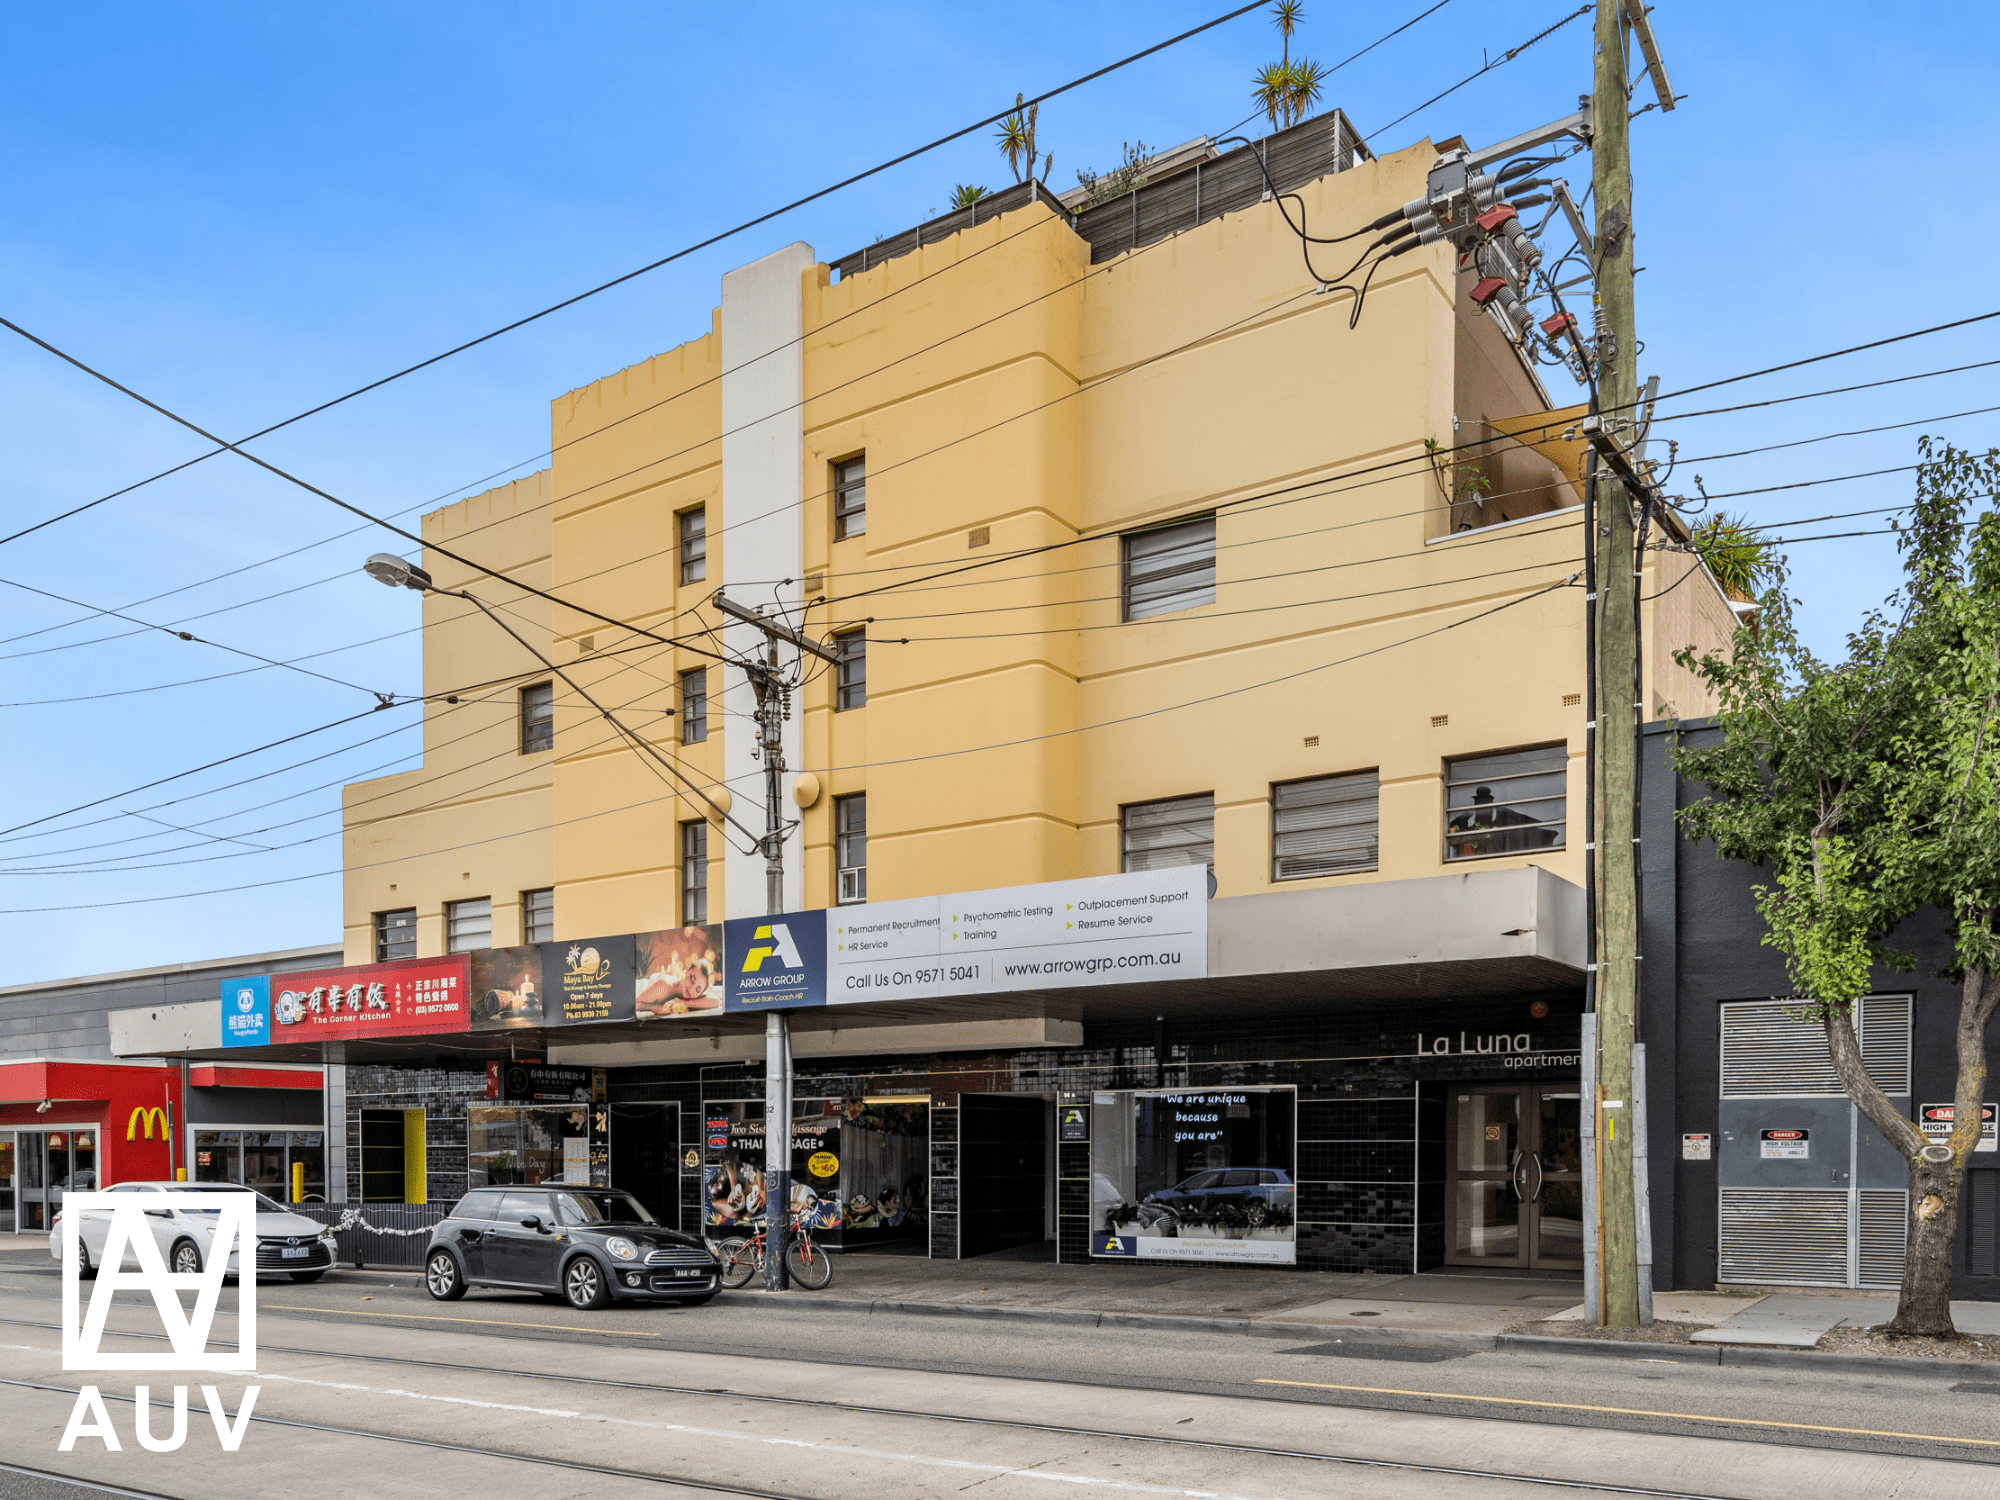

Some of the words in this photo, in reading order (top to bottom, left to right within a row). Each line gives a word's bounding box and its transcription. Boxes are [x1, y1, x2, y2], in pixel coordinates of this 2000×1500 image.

[1078, 896, 1147, 911] Outplacement
[1150, 891, 1188, 905] Support
[964, 909, 1021, 923] Psychometric
[1023, 906, 1053, 917] Testing
[848, 923, 890, 935] Permanent
[893, 917, 940, 930] Recruitment
[1079, 919, 1115, 929] Resume
[1118, 915, 1153, 926] Service
[964, 930, 997, 941] Training
[848, 943, 858, 951] HR
[860, 940, 888, 950] Service
[1005, 952, 1181, 976] www.arrowgrp.com.au
[415, 977, 456, 991] 正宗川湘菜
[564, 975, 581, 985] Maya
[582, 975, 594, 984] Bay
[740, 977, 771, 988] ARROW
[773, 974, 804, 986] GROUP
[846, 975, 871, 989] Call
[875, 974, 889, 987] Us
[893, 971, 912, 985] On
[916, 968, 944, 983] 9571
[950, 965, 979, 981] 5041
[570, 993, 584, 1001] Open
[415, 1006, 427, 1015] (03)
[428, 1004, 443, 1013] 9572
[443, 1003, 459, 1011] 0600
[228, 1013, 263, 1030] 熊猫外卖
[312, 1016, 327, 1025] The
[330, 1014, 356, 1023] Corner
[360, 1012, 391, 1021] Kitchen
[1418, 1033, 1449, 1055] La
[1461, 1031, 1530, 1053] Luna
[1505, 1054, 1581, 1070] apartmen
[1208, 1093, 1246, 1106] unique
[1176, 1112, 1218, 1121] because
[730, 1121, 746, 1135] Two
[739, 1139, 762, 1149] THAI
[1174, 1132, 1194, 1142] you
[529, 1156, 546, 1174] Day
[1215, 1251, 1279, 1259] www.arrowgrp.com.au
